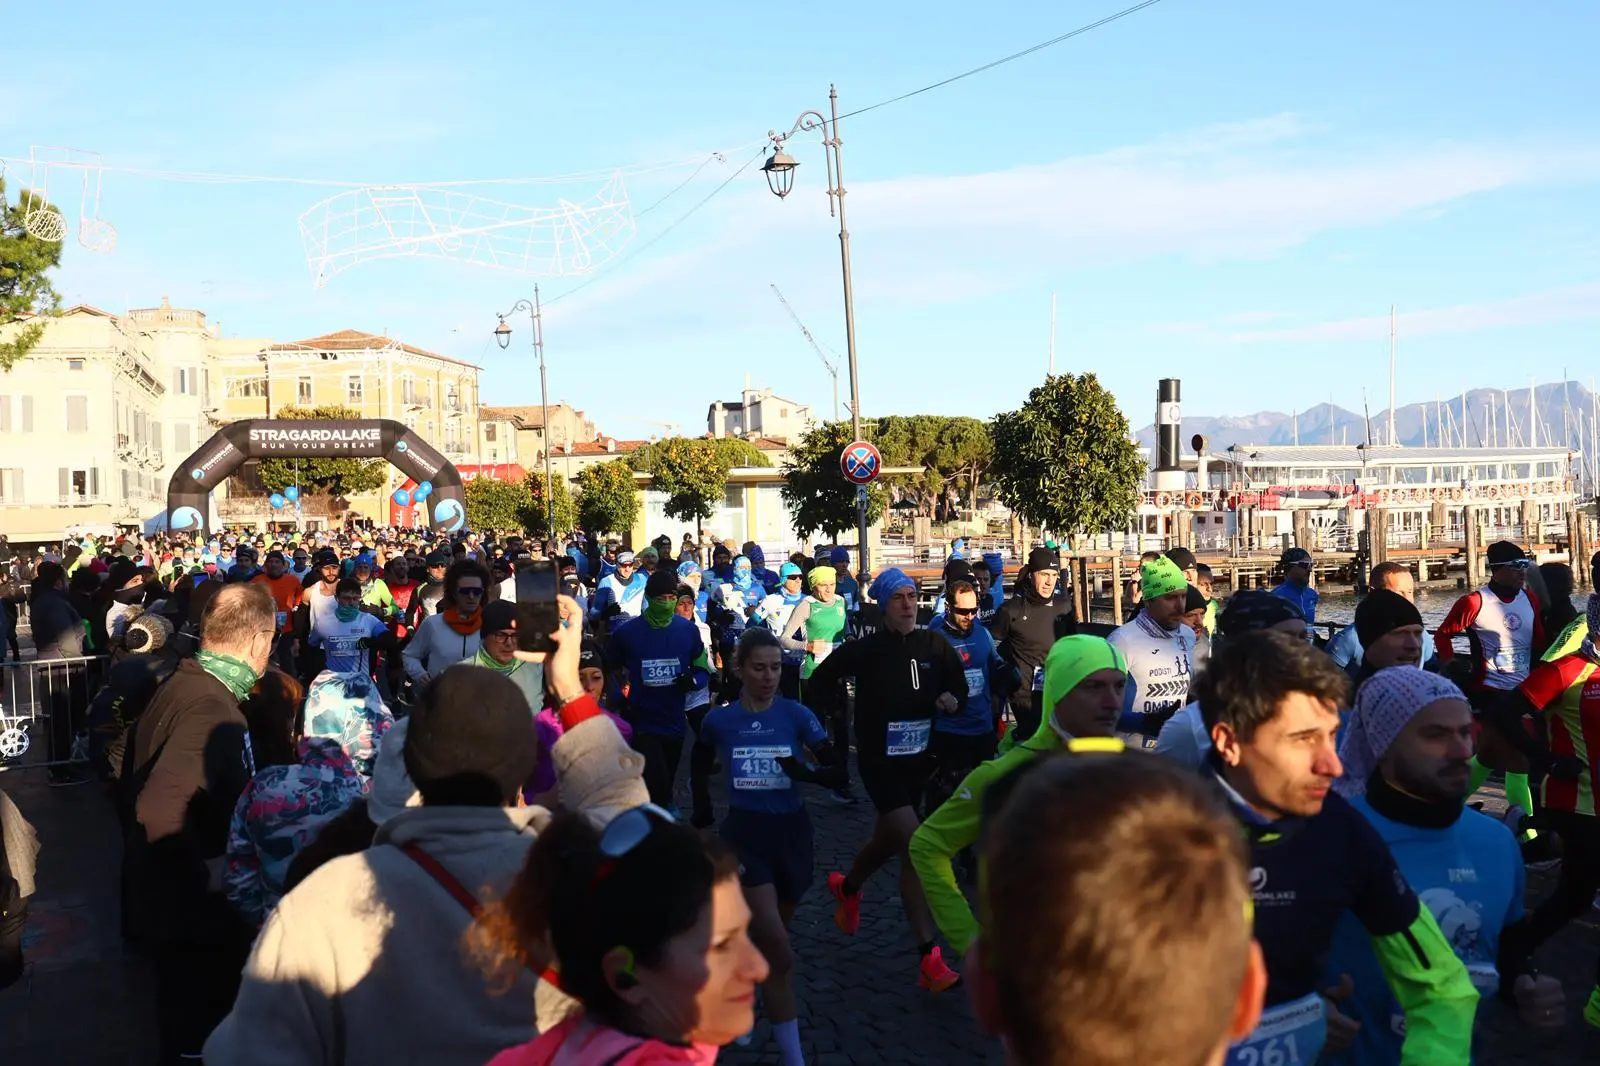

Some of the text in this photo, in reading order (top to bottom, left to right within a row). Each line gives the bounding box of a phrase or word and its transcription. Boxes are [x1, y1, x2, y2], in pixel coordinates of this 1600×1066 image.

[249, 428, 381, 441] STRAGARDALAKE
[648, 666, 676, 678] 3641
[1149, 667, 1173, 678] PODISTI
[740, 759, 783, 774] 4130
[1237, 1033, 1299, 1066] 261
